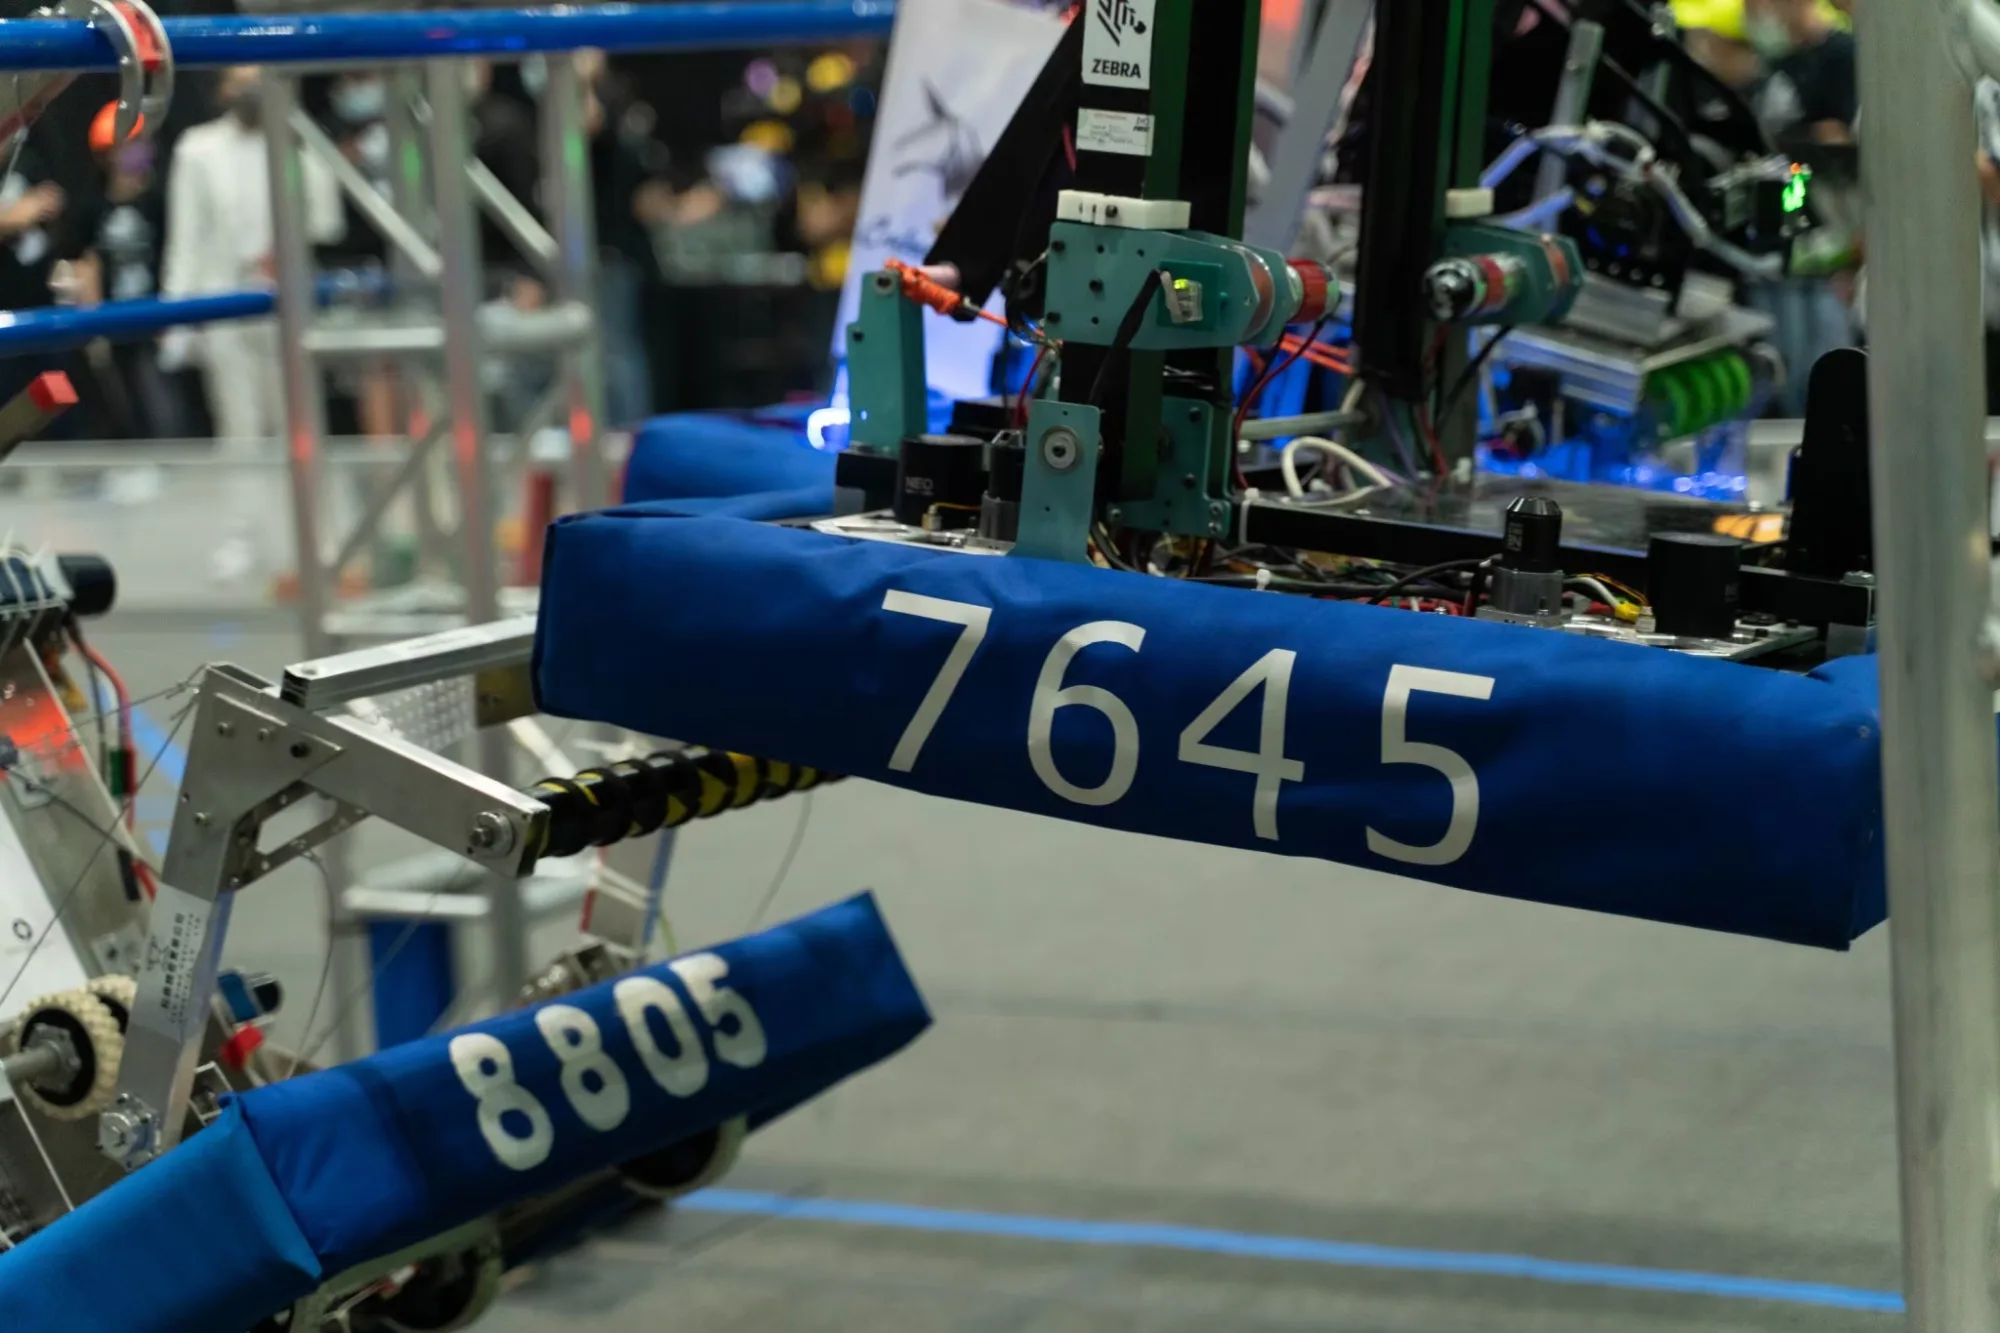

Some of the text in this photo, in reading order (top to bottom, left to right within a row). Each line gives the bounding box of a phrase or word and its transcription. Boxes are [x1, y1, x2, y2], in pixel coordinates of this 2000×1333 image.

[1091, 58, 1142, 79] ZEBRA
[882, 589, 1495, 865] 7645
[449, 953, 767, 1171] 8805
